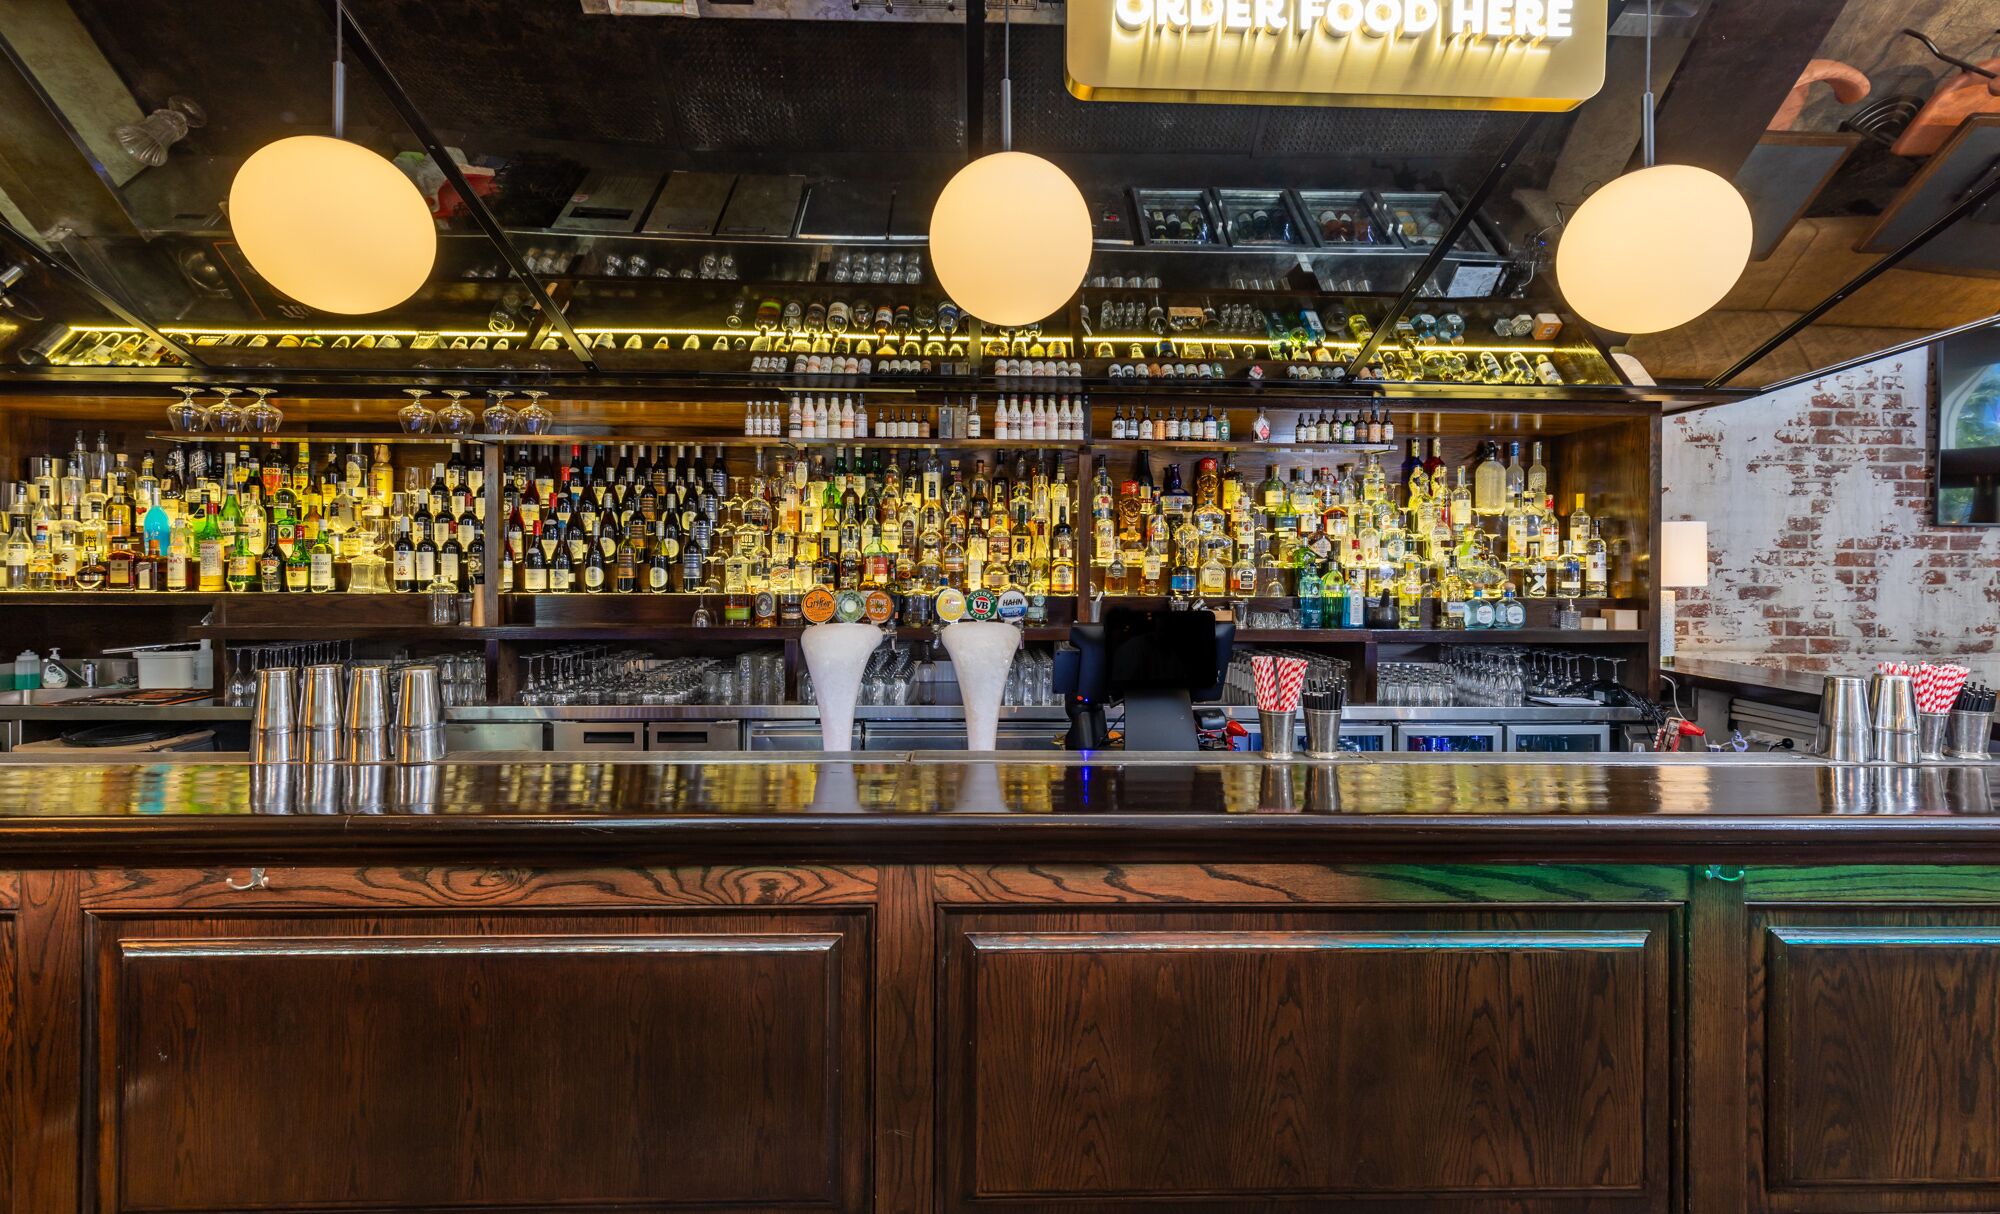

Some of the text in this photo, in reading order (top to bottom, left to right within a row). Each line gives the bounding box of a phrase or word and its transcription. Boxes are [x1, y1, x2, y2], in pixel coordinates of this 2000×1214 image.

[1115, 0, 1573, 37] ORDER FOOD HERE
[970, 591, 995, 603] VICTORIA
[1002, 598, 1024, 606] HAHN
[975, 600, 989, 609] VB
[970, 609, 992, 619] BITTER
